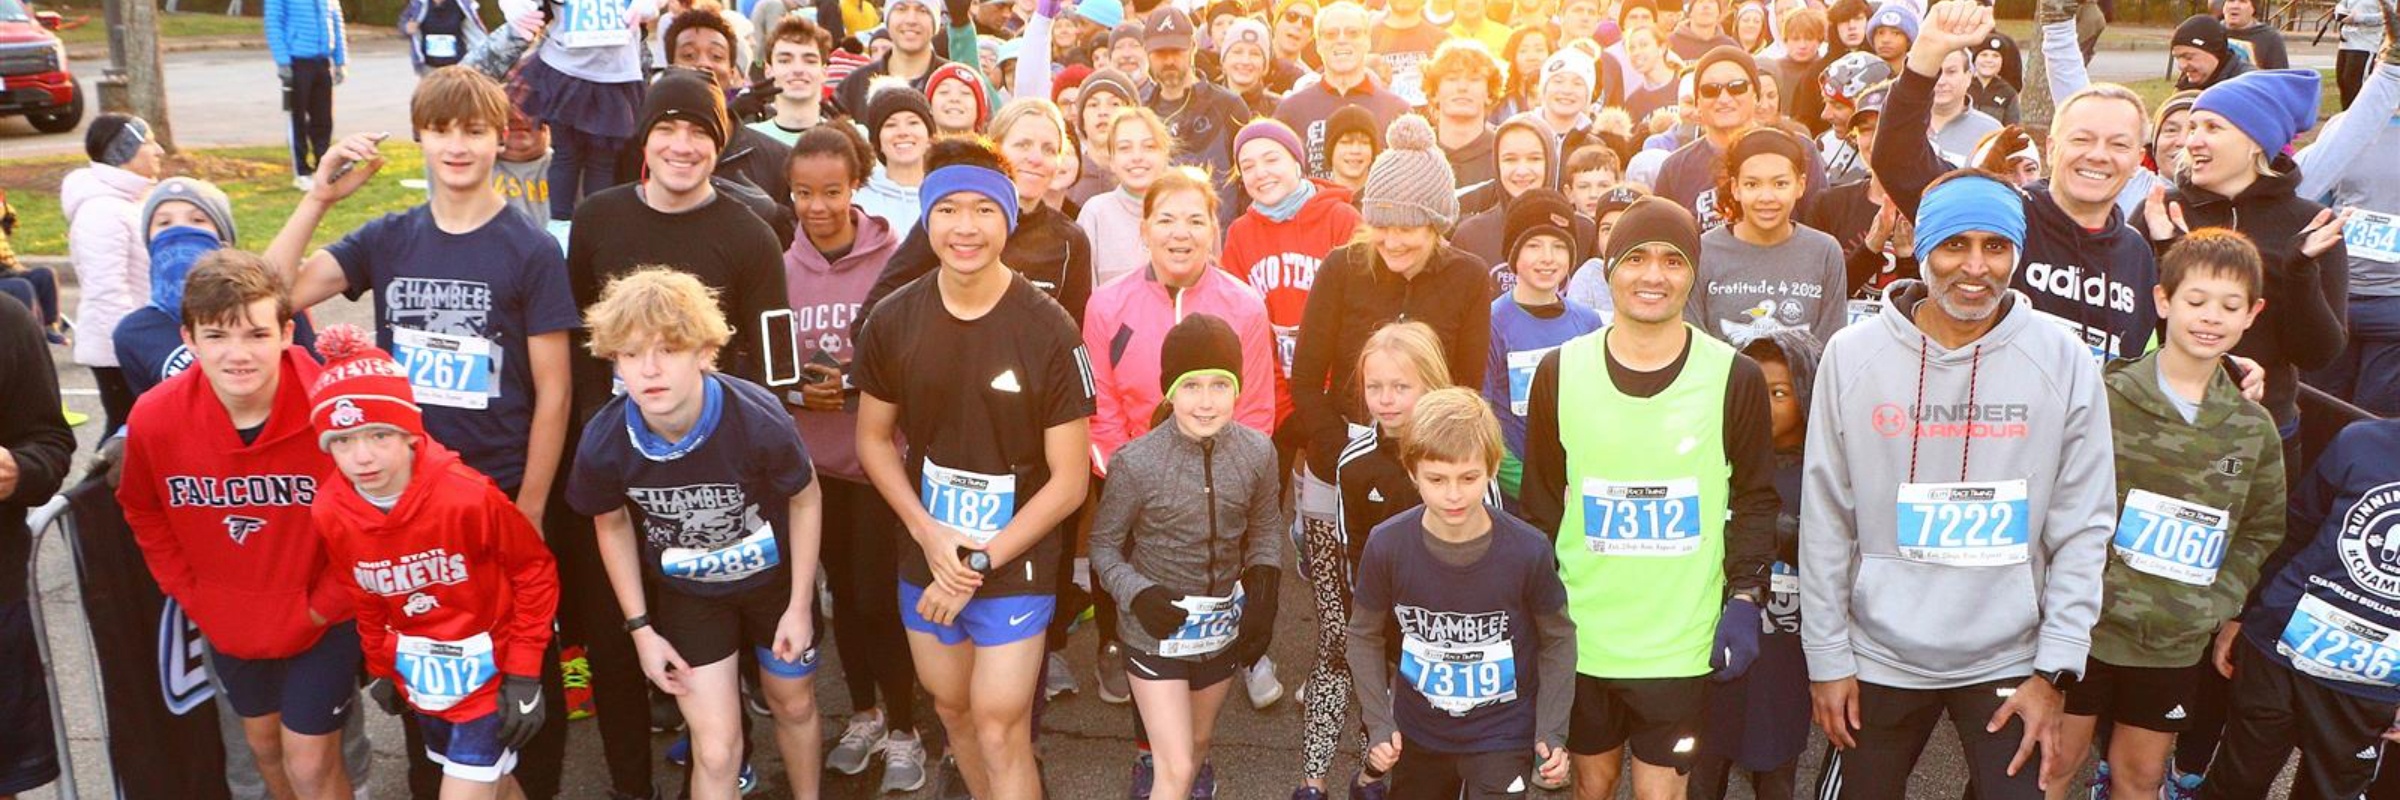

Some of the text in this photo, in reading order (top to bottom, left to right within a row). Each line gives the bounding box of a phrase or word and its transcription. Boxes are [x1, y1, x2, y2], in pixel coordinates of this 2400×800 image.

[385, 279, 492, 311] CHAMBLEE
[1708, 279, 1822, 298] Gratitude 4 2022
[2026, 262, 2135, 313] adidas
[400, 346, 475, 390] 7267
[1909, 403, 2028, 421] UNDER
[1910, 424, 2028, 438] ARMOUR
[166, 474, 316, 508] FALCONS
[928, 479, 1000, 531] 7182
[1595, 498, 1686, 539] 7312
[1912, 503, 2013, 546] 7222
[677, 544, 766, 578] 7283
[2131, 511, 2225, 569] 7060
[2347, 549, 2400, 593] #CHAM
[1394, 604, 1509, 642] CHAMBLEE
[2297, 617, 2398, 680] 7236
[405, 653, 484, 695] 7012
[1414, 656, 1500, 698] 7319
